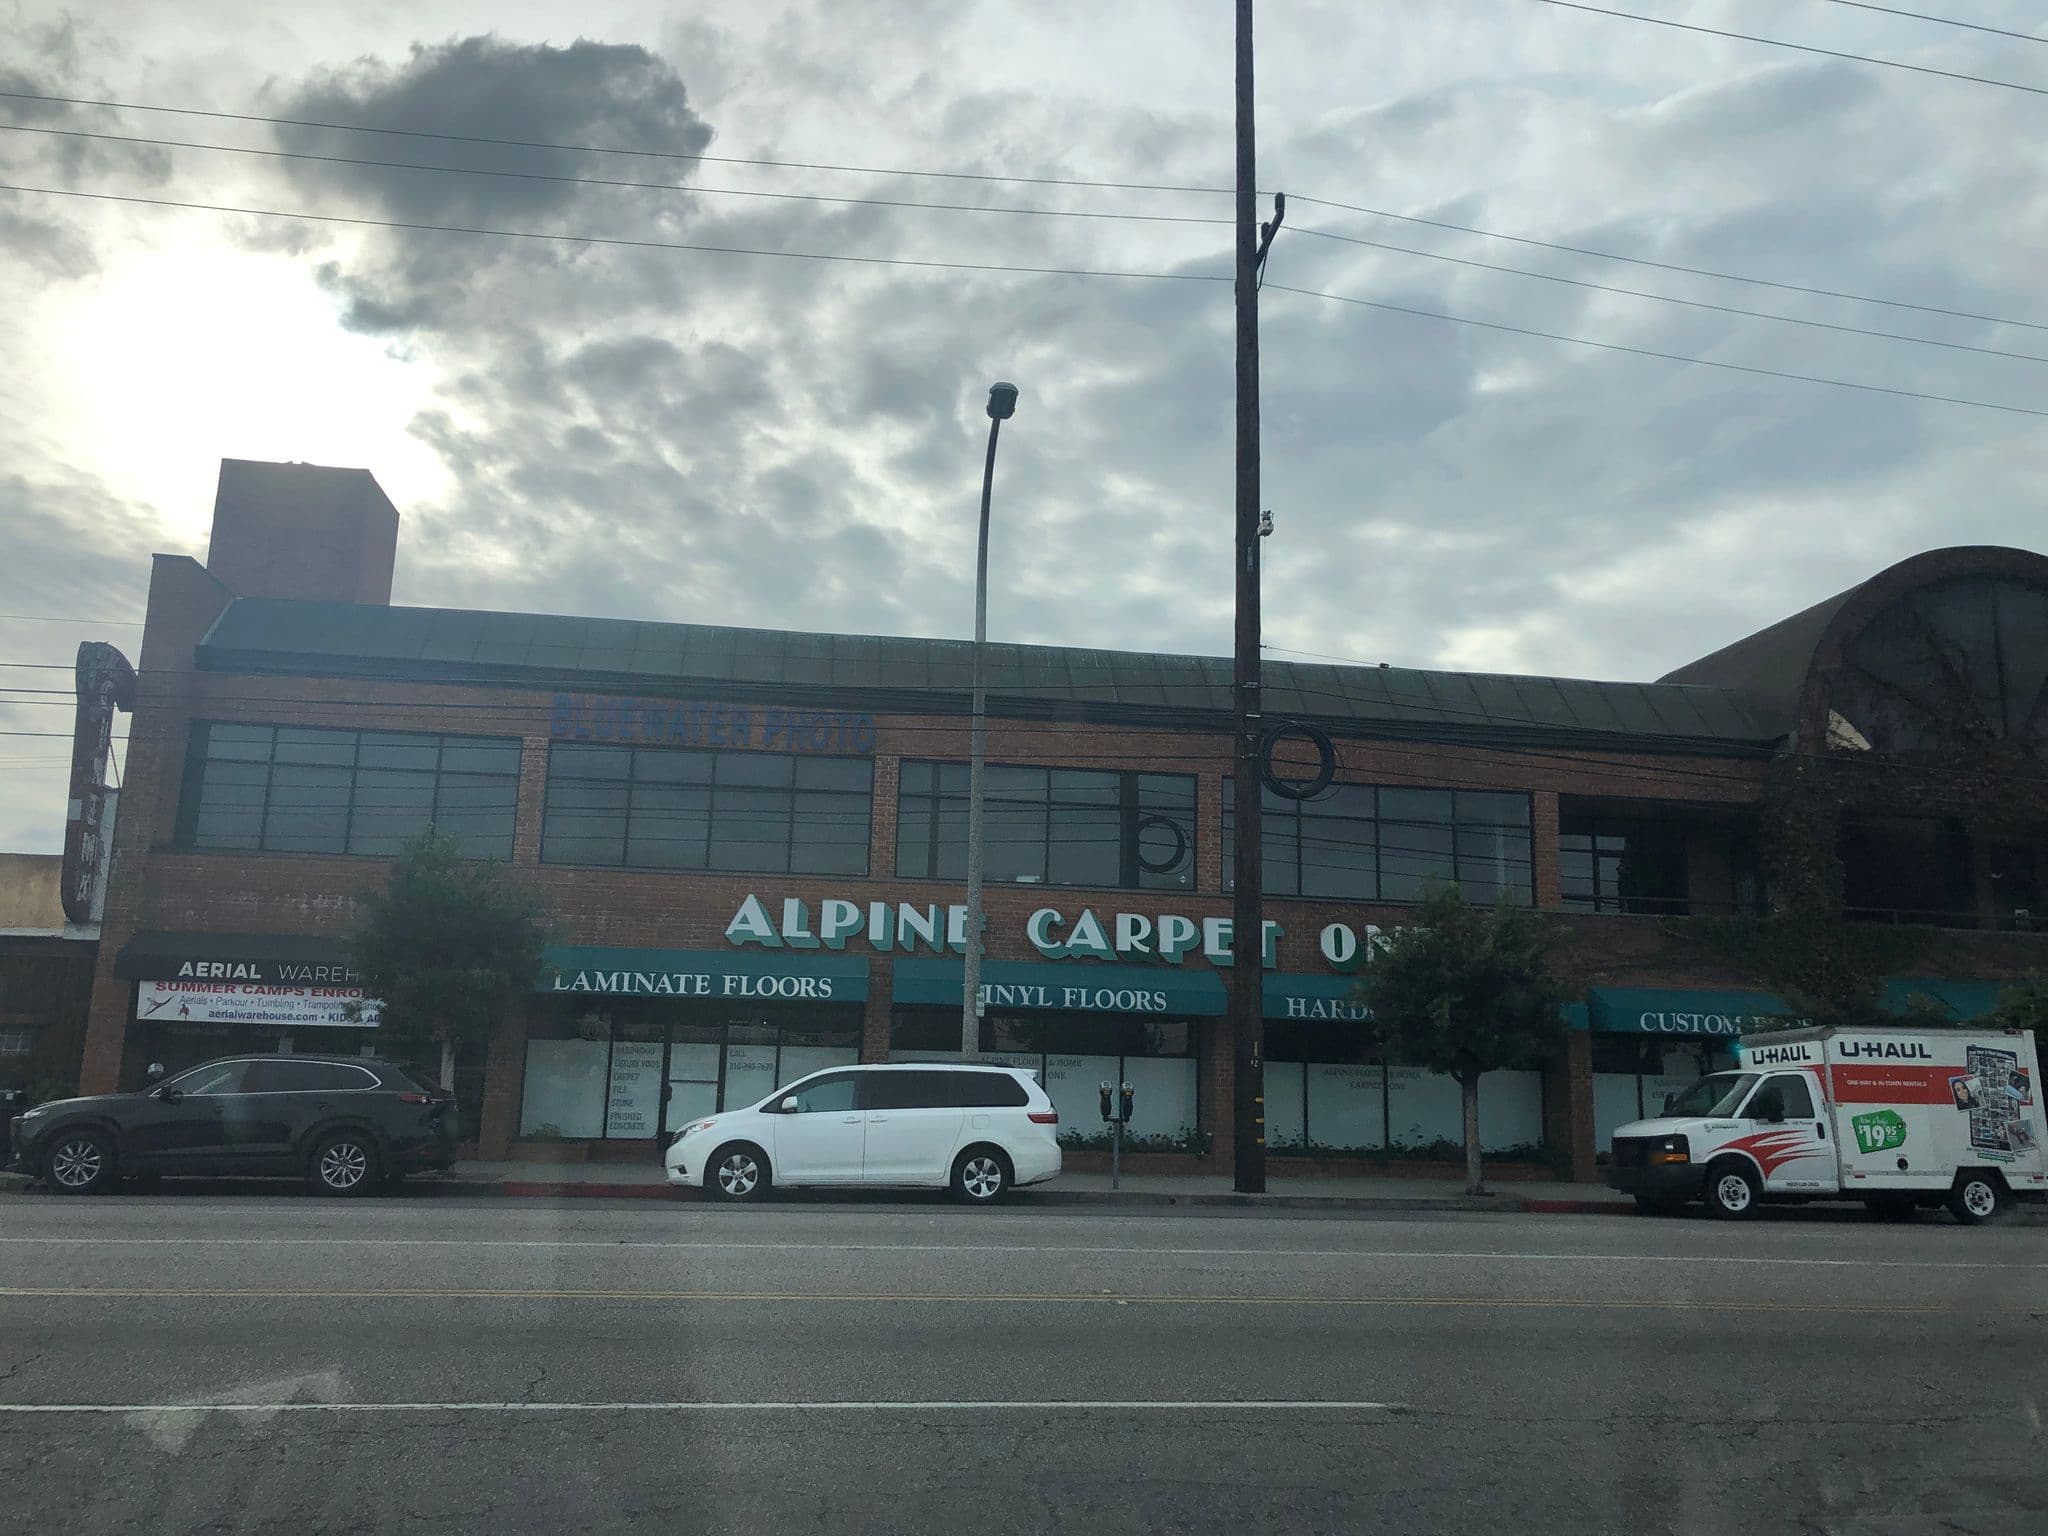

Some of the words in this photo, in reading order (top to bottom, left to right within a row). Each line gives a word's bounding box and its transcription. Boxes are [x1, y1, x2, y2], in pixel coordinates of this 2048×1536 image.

[550, 693, 749, 745] BLUEWATER
[763, 710, 875, 751] PHOTO
[724, 893, 985, 954] ALPINE
[1320, 922, 1402, 973] ON
[178, 960, 262, 979] AERIAL
[278, 963, 359, 983] WAREH
[155, 980, 236, 994] SUMMER
[241, 984, 305, 997] CAMPS
[311, 987, 362, 998] ENRO
[552, 970, 711, 995] LAMINATE
[722, 974, 832, 998] FLOORS
[179, 994, 208, 1006] Aerials
[216, 996, 248, 1007] Parkour
[257, 997, 295, 1010] Tumbling
[303, 999, 346, 1012] Trampolin
[968, 981, 1052, 1006] INYL
[1062, 987, 1167, 1011] FLOORS
[208, 1009, 318, 1022] aerialwarehouse.com
[1286, 997, 1374, 1020] HARD
[1640, 1012, 1743, 1035] CUSTOM
[1752, 1045, 1811, 1065] U-HAUL
[1840, 1041, 1932, 1059] U-HAUL
